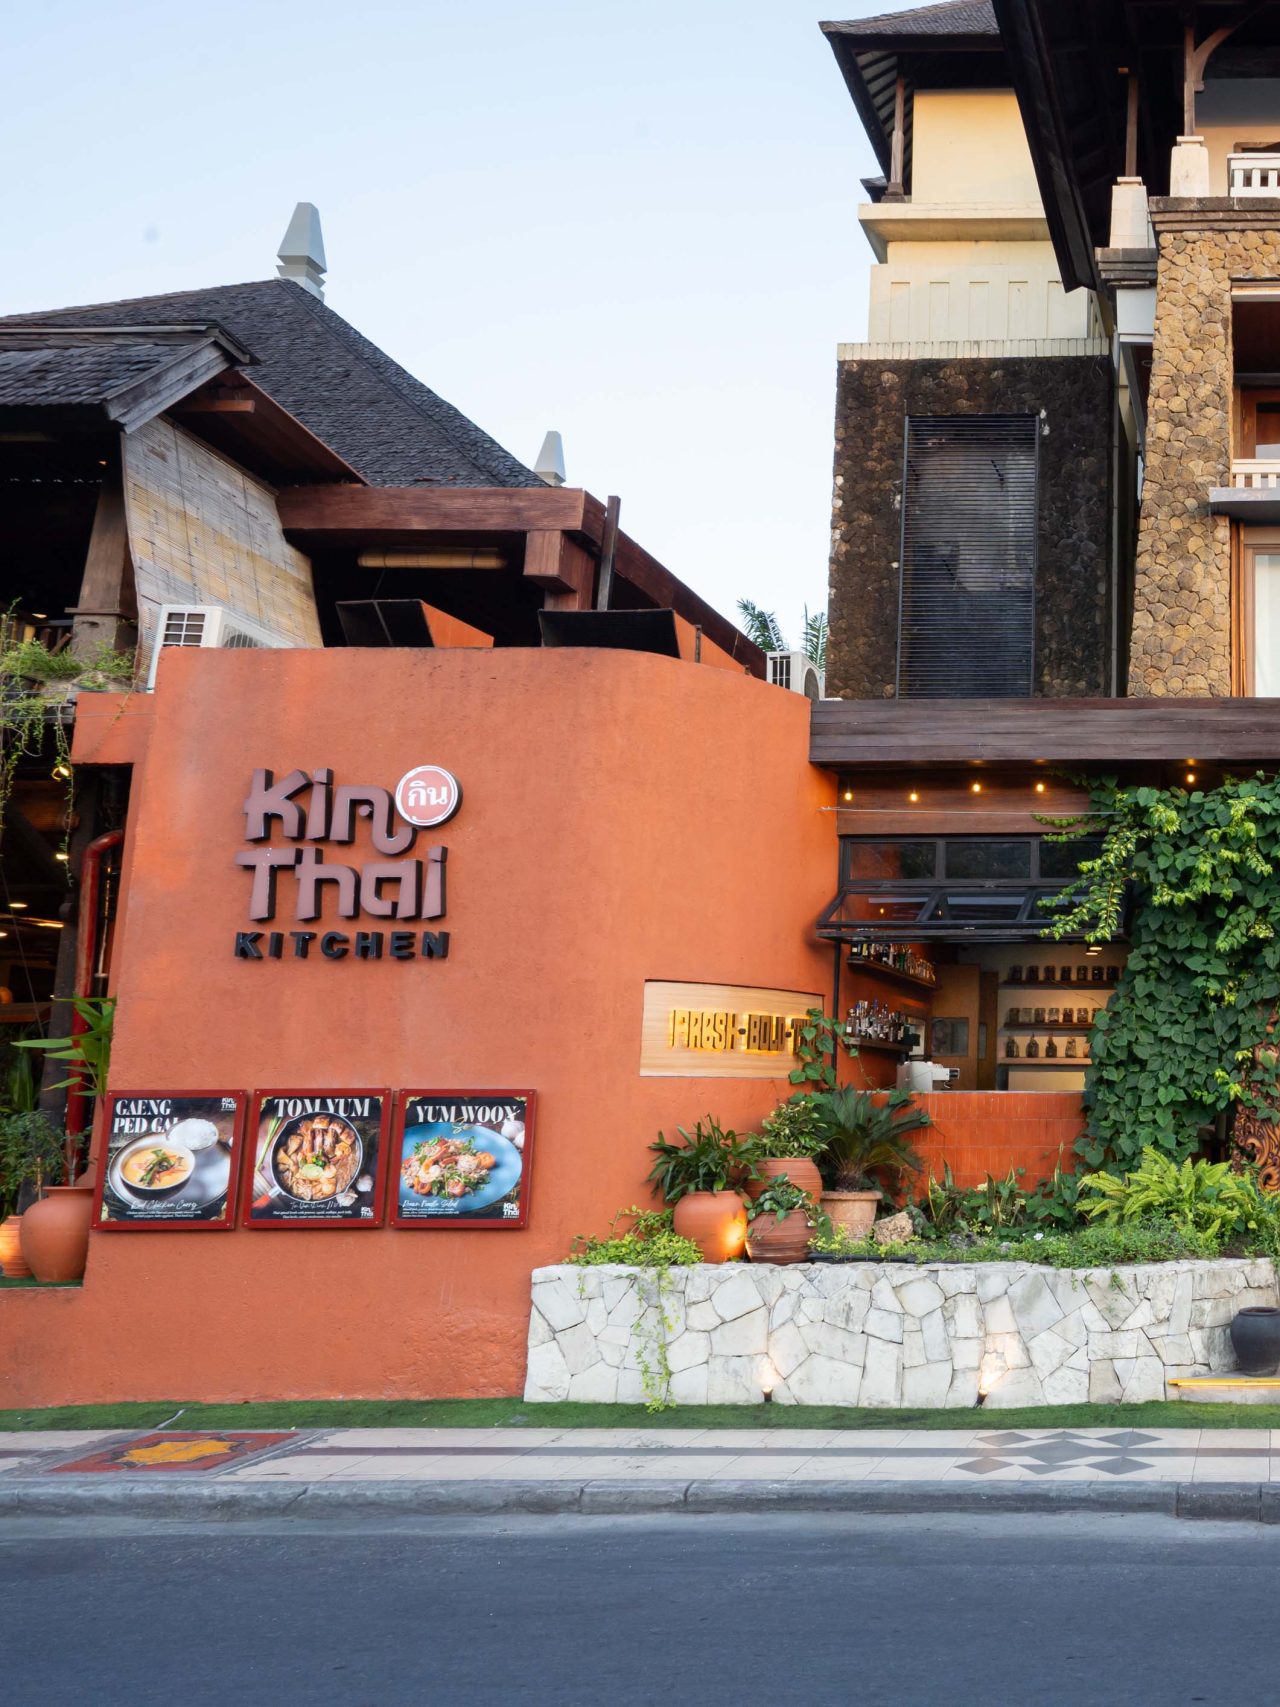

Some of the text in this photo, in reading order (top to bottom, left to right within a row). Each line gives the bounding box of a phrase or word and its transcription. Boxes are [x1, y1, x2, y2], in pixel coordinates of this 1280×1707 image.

[408, 780, 448, 807] กิน
[243, 768, 417, 855] Kin
[234, 846, 448, 921] Thai
[234, 931, 450, 960] KITCHEN
[115, 1099, 172, 1116] GAENG
[274, 1098, 371, 1117] TOM YUM
[416, 1105, 457, 1123] YUM
[113, 1117, 148, 1134] PED
